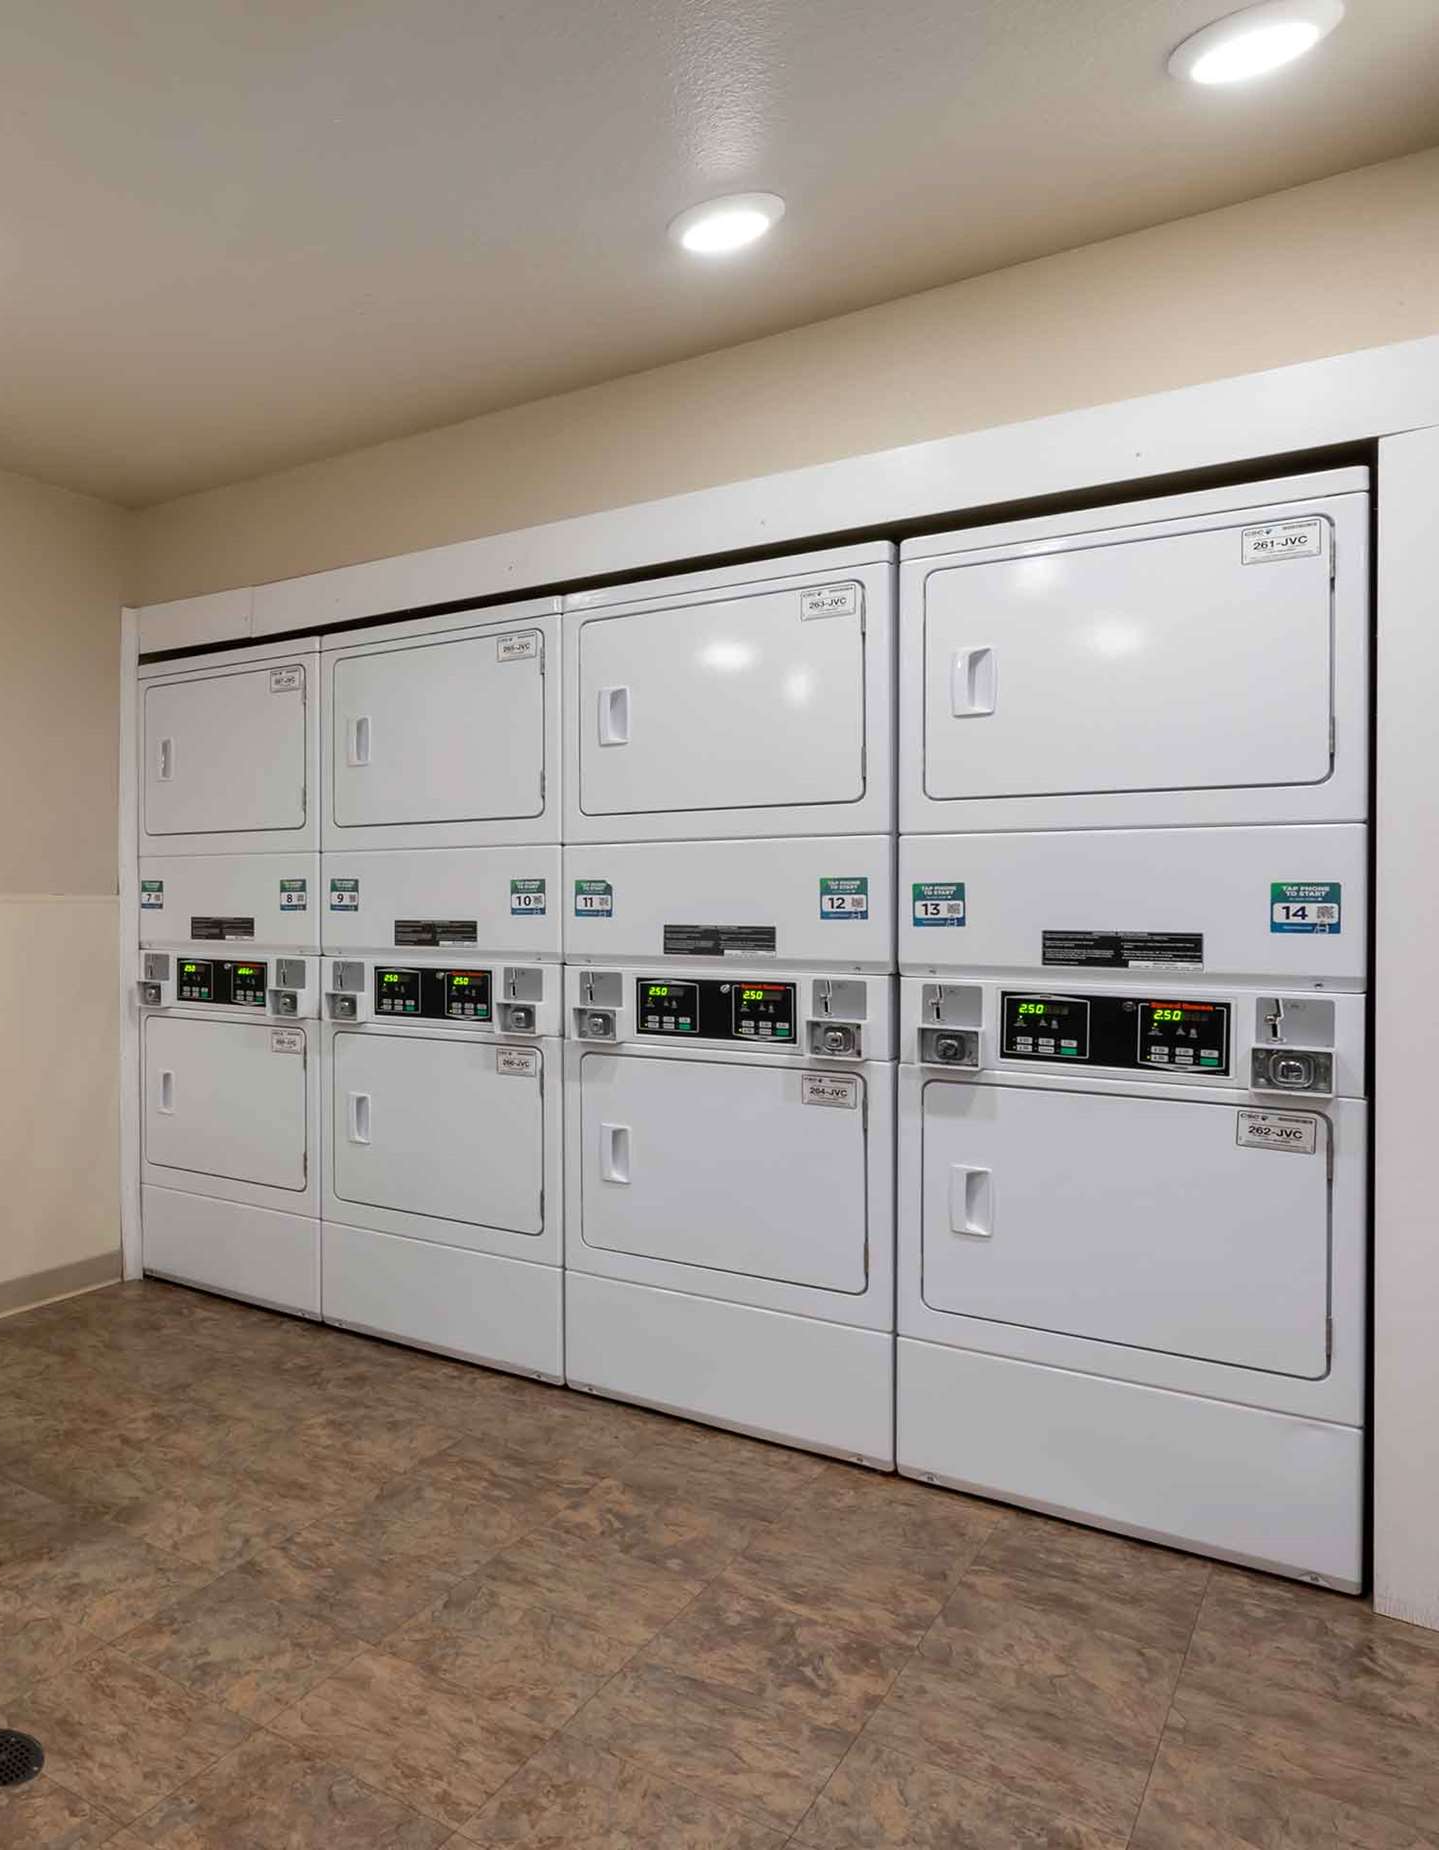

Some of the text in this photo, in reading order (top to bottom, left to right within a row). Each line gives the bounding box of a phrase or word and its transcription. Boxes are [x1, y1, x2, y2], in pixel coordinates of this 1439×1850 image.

[1253, 535, 1308, 551] 261-JVC
[146, 893, 152, 902] 7
[286, 893, 293, 903] 8
[337, 893, 344, 903] 9
[516, 895, 532, 907] 10
[582, 897, 593, 908] 11
[828, 897, 846, 910] 12
[921, 902, 941, 916] 13
[1282, 905, 1309, 920] 14
[1248, 1125, 1303, 1139] 262-JVC
